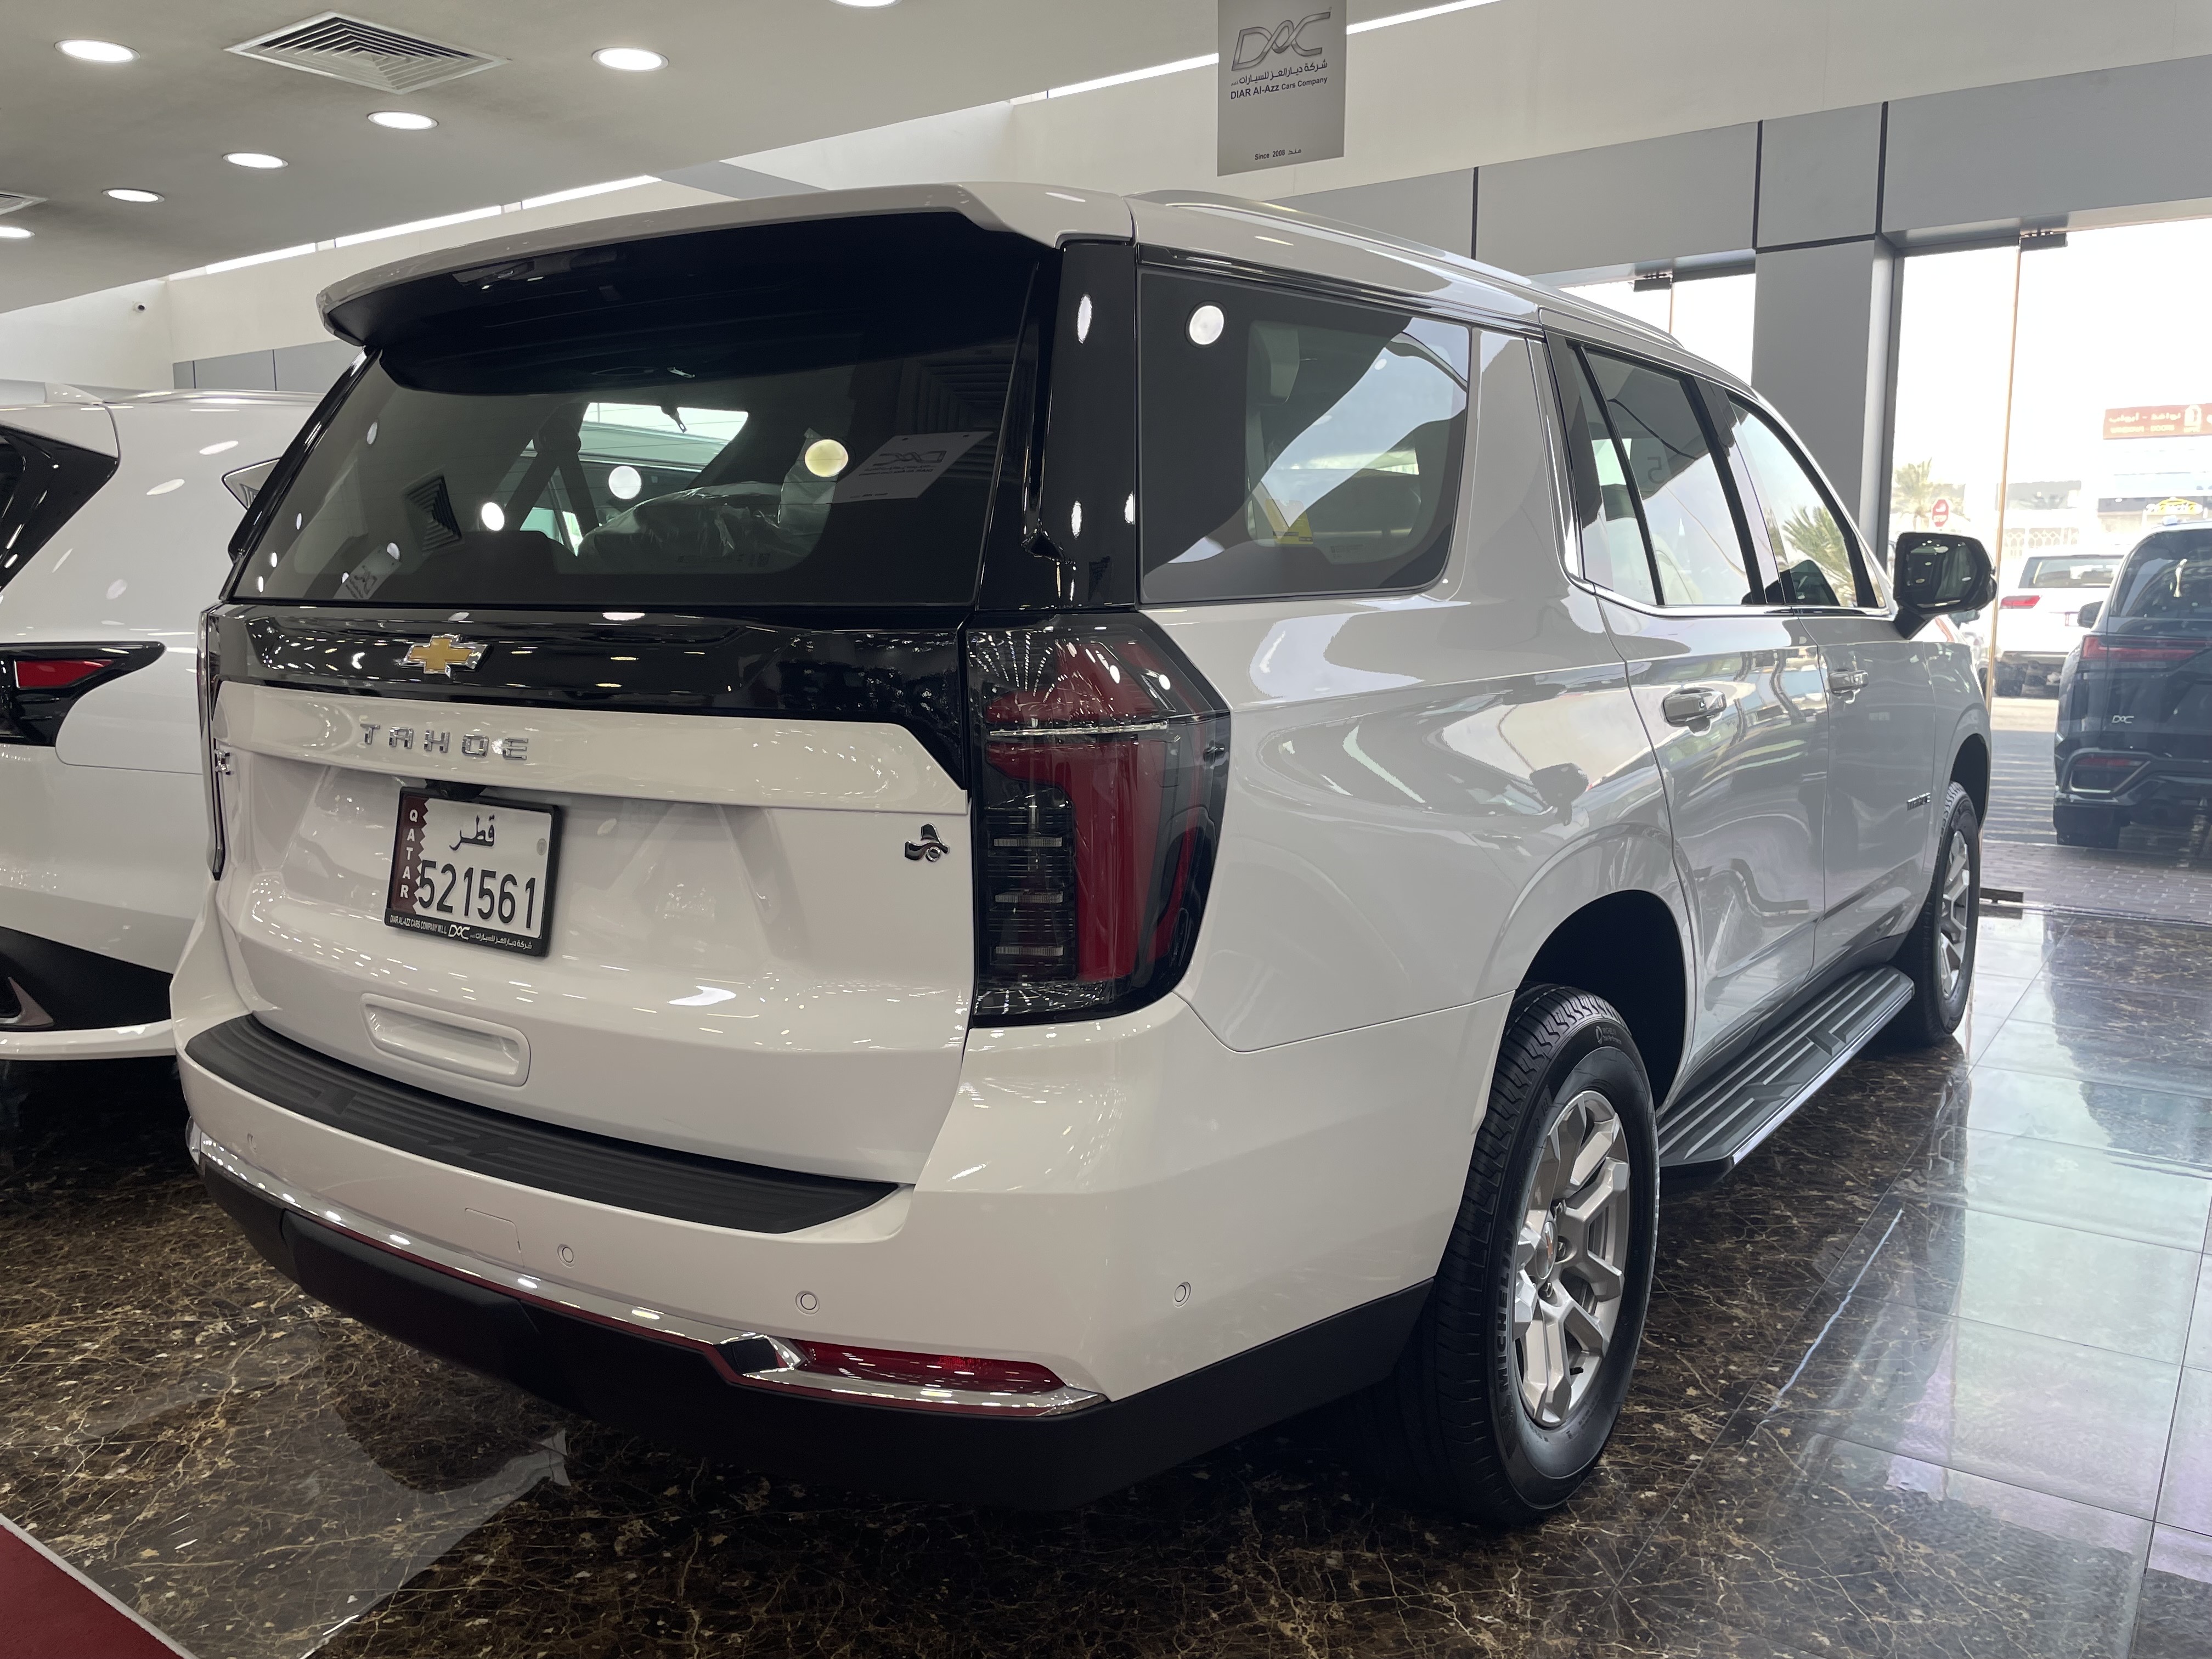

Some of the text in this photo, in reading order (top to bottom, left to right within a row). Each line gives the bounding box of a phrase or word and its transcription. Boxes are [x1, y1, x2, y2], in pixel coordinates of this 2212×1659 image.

[1304, 59, 1328, 72] شركة
[1231, 88, 1251, 100] DIAR
[1253, 84, 1279, 95] Al-Azz
[1297, 77, 1328, 87] Company
[360, 723, 529, 761] TAHOE
[449, 815, 495, 851] قطر
[399, 809, 419, 899] QATAR
[418, 859, 537, 929] 521561
